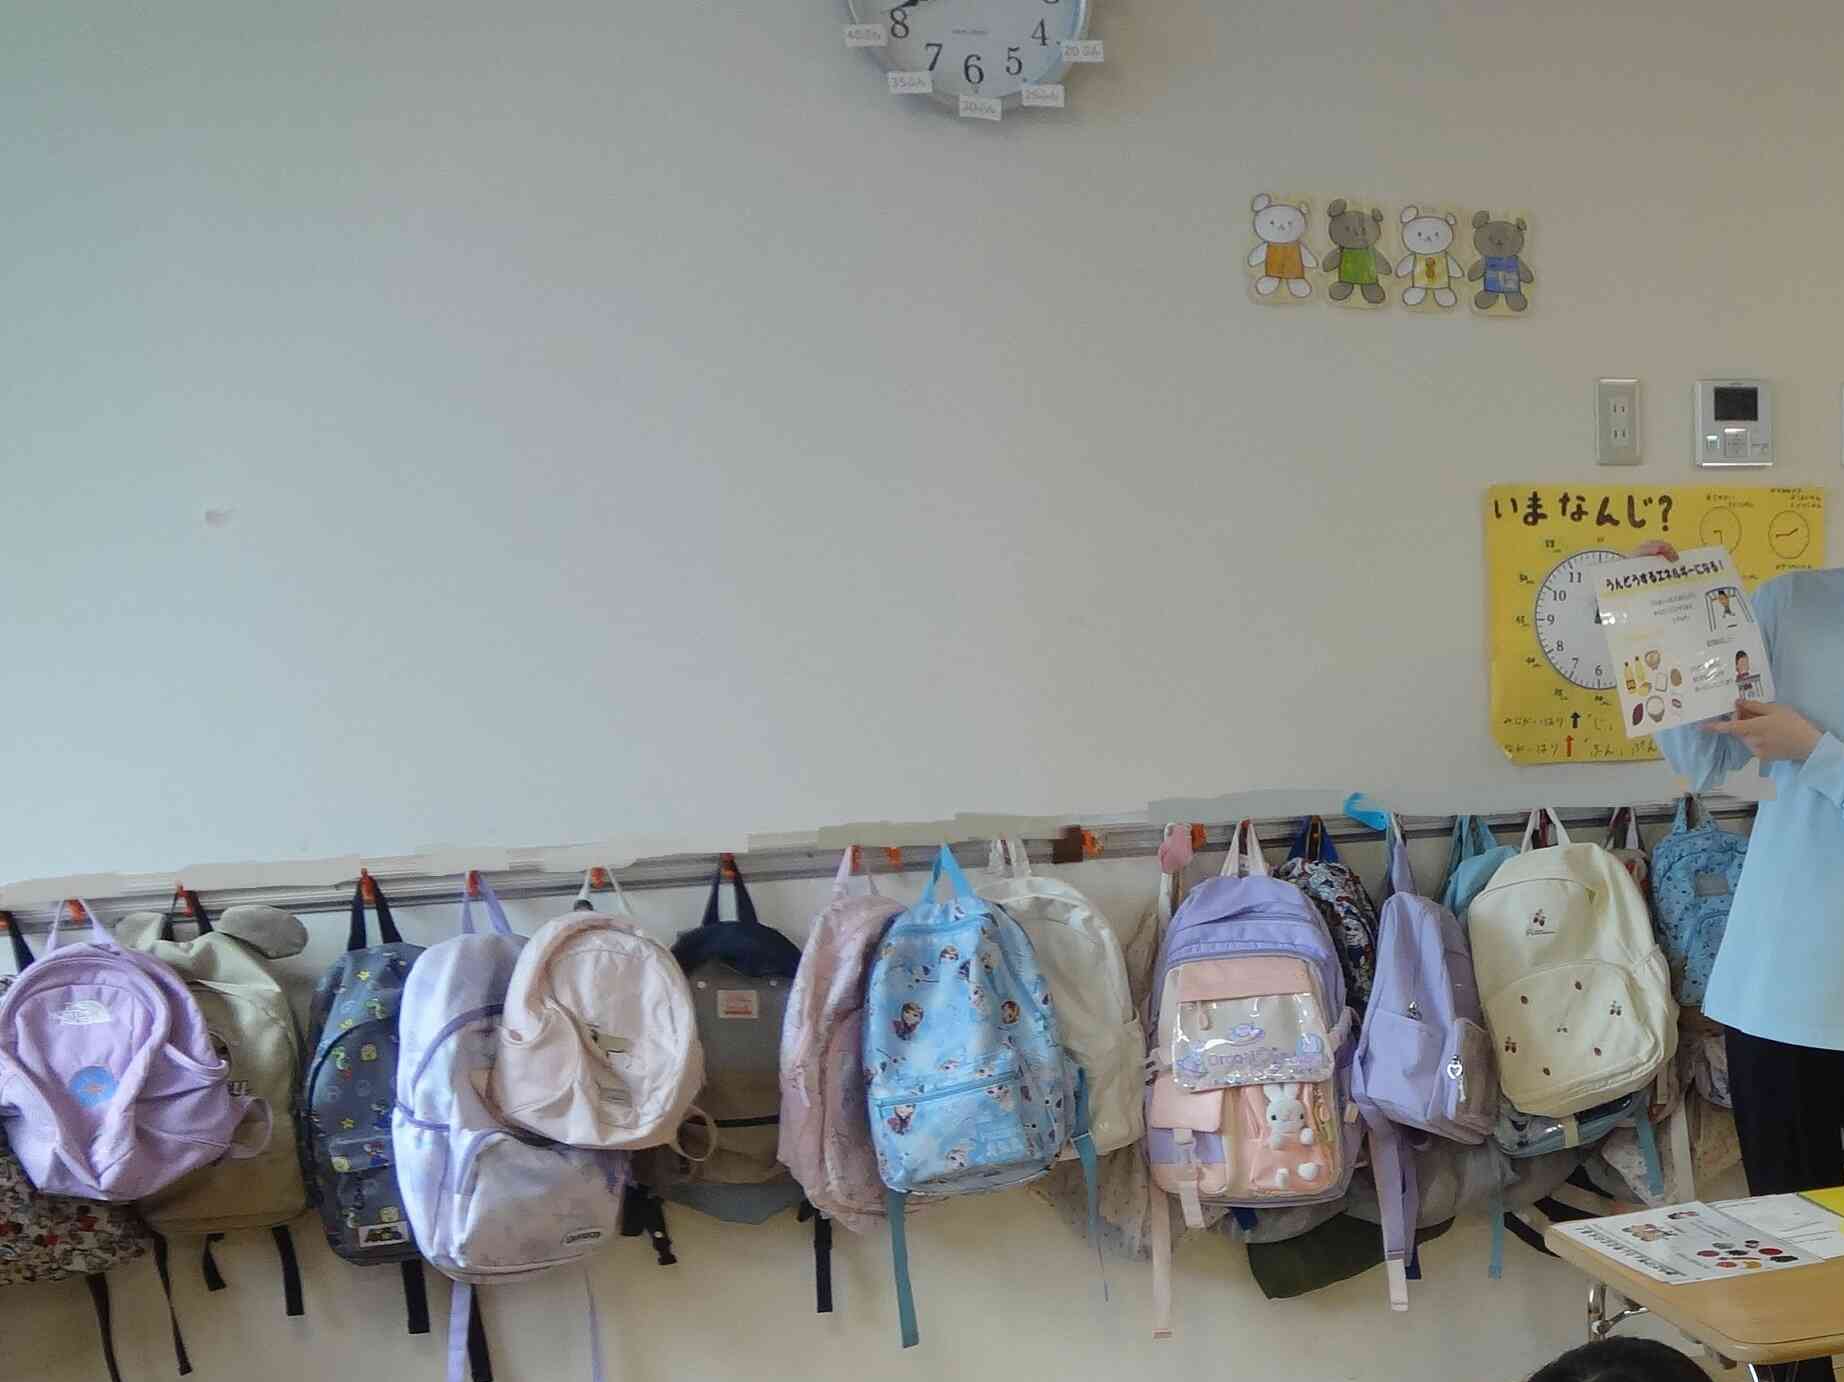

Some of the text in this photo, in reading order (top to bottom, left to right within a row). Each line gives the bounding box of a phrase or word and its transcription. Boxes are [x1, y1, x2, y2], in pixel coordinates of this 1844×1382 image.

[890, 8, 909, 38] 8
[1032, 18, 1048, 46] 4
[925, 43, 942, 71] 7
[1006, 47, 1022, 75] 5
[964, 54, 984, 84] 6
[1569, 572, 1583, 584] 11
[1552, 590, 1566, 602] 10
[1546, 614, 1555, 625] 9
[1556, 640, 1565, 652] 8
[1571, 657, 1579, 669] 7
[1595, 664, 1603, 677] 6
